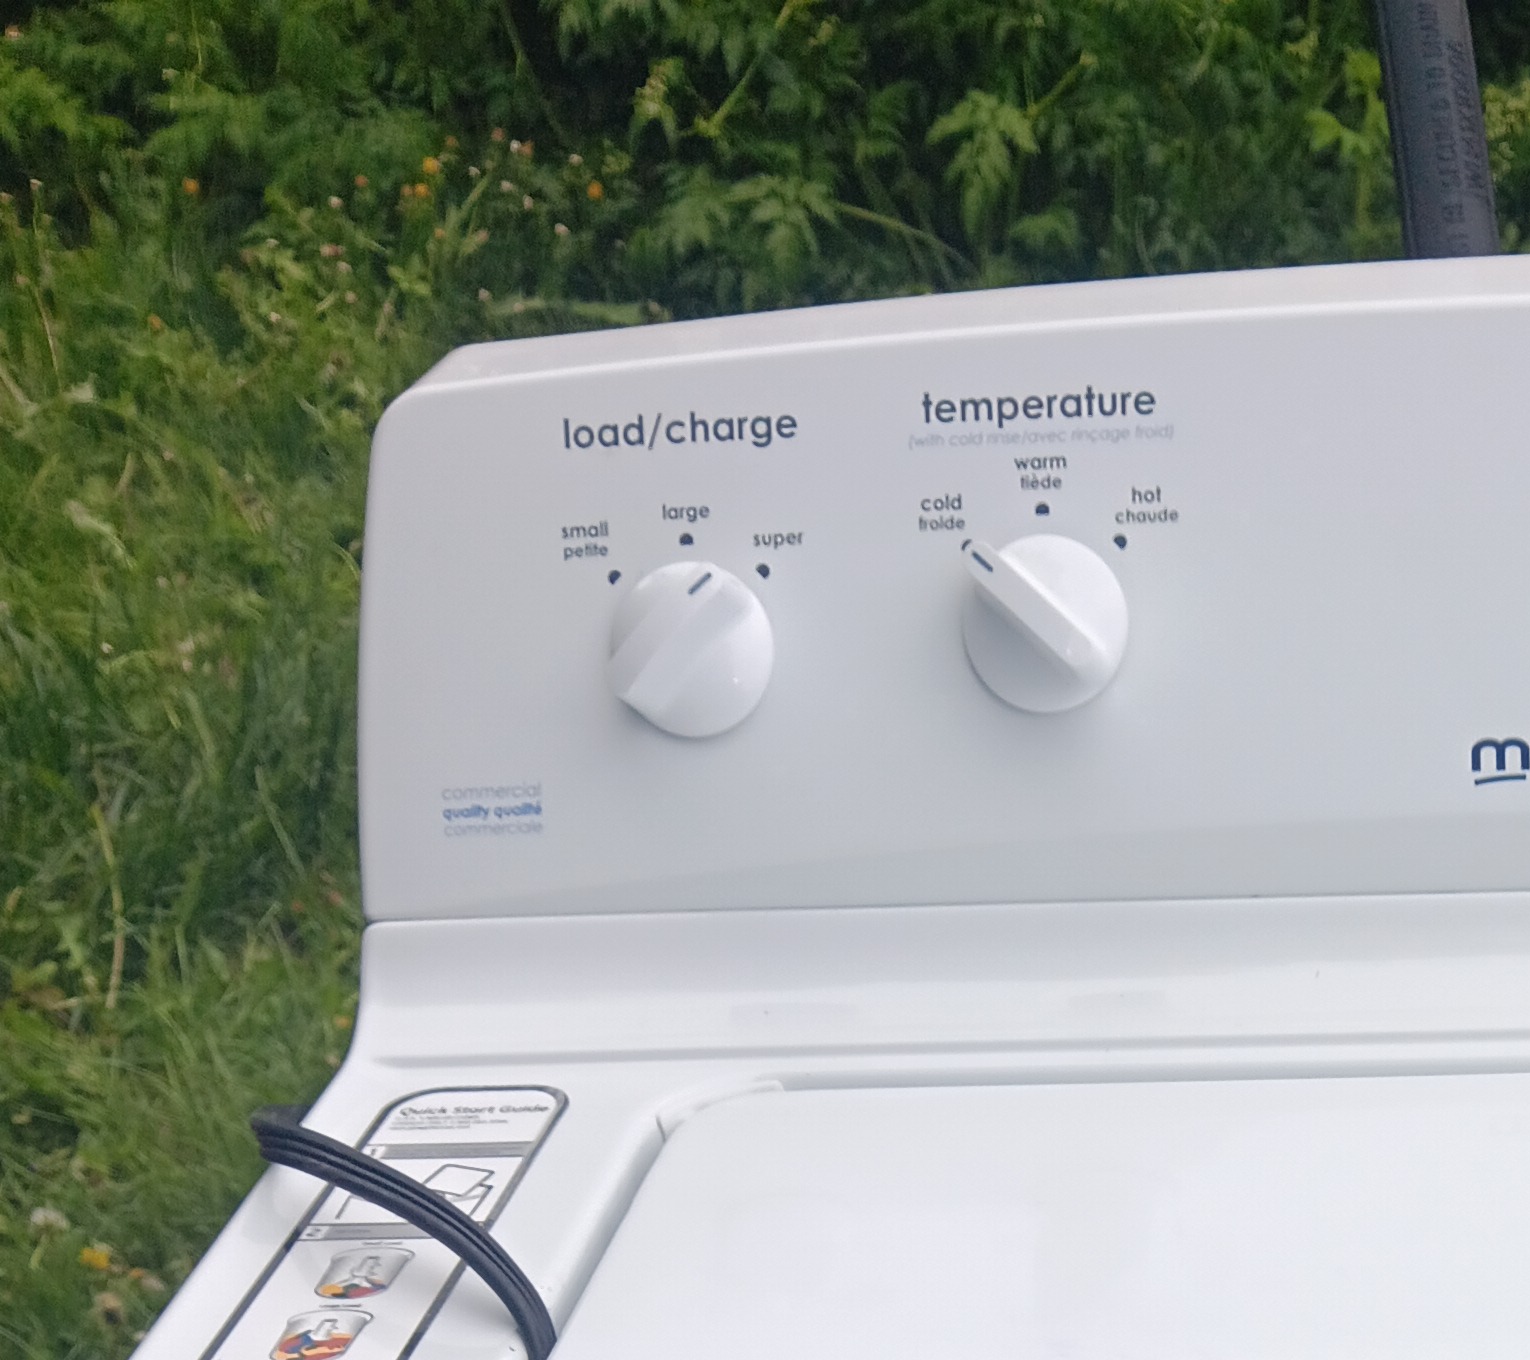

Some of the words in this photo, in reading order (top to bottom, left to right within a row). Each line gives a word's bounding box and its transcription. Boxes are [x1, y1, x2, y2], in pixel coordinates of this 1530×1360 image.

[922, 385, 1156, 428] temperature
[563, 411, 798, 450] load/charge
[1014, 455, 1067, 470] warm
[1020, 472, 1062, 490] tiède
[921, 493, 962, 512] cold
[1131, 486, 1161, 504] hot
[662, 504, 710, 522] large
[1115, 508, 1179, 525] chaude
[561, 521, 609, 539] small
[918, 515, 966, 531] froide
[753, 530, 804, 550] super
[564, 543, 609, 560] petite
[442, 782, 542, 800] commercial
